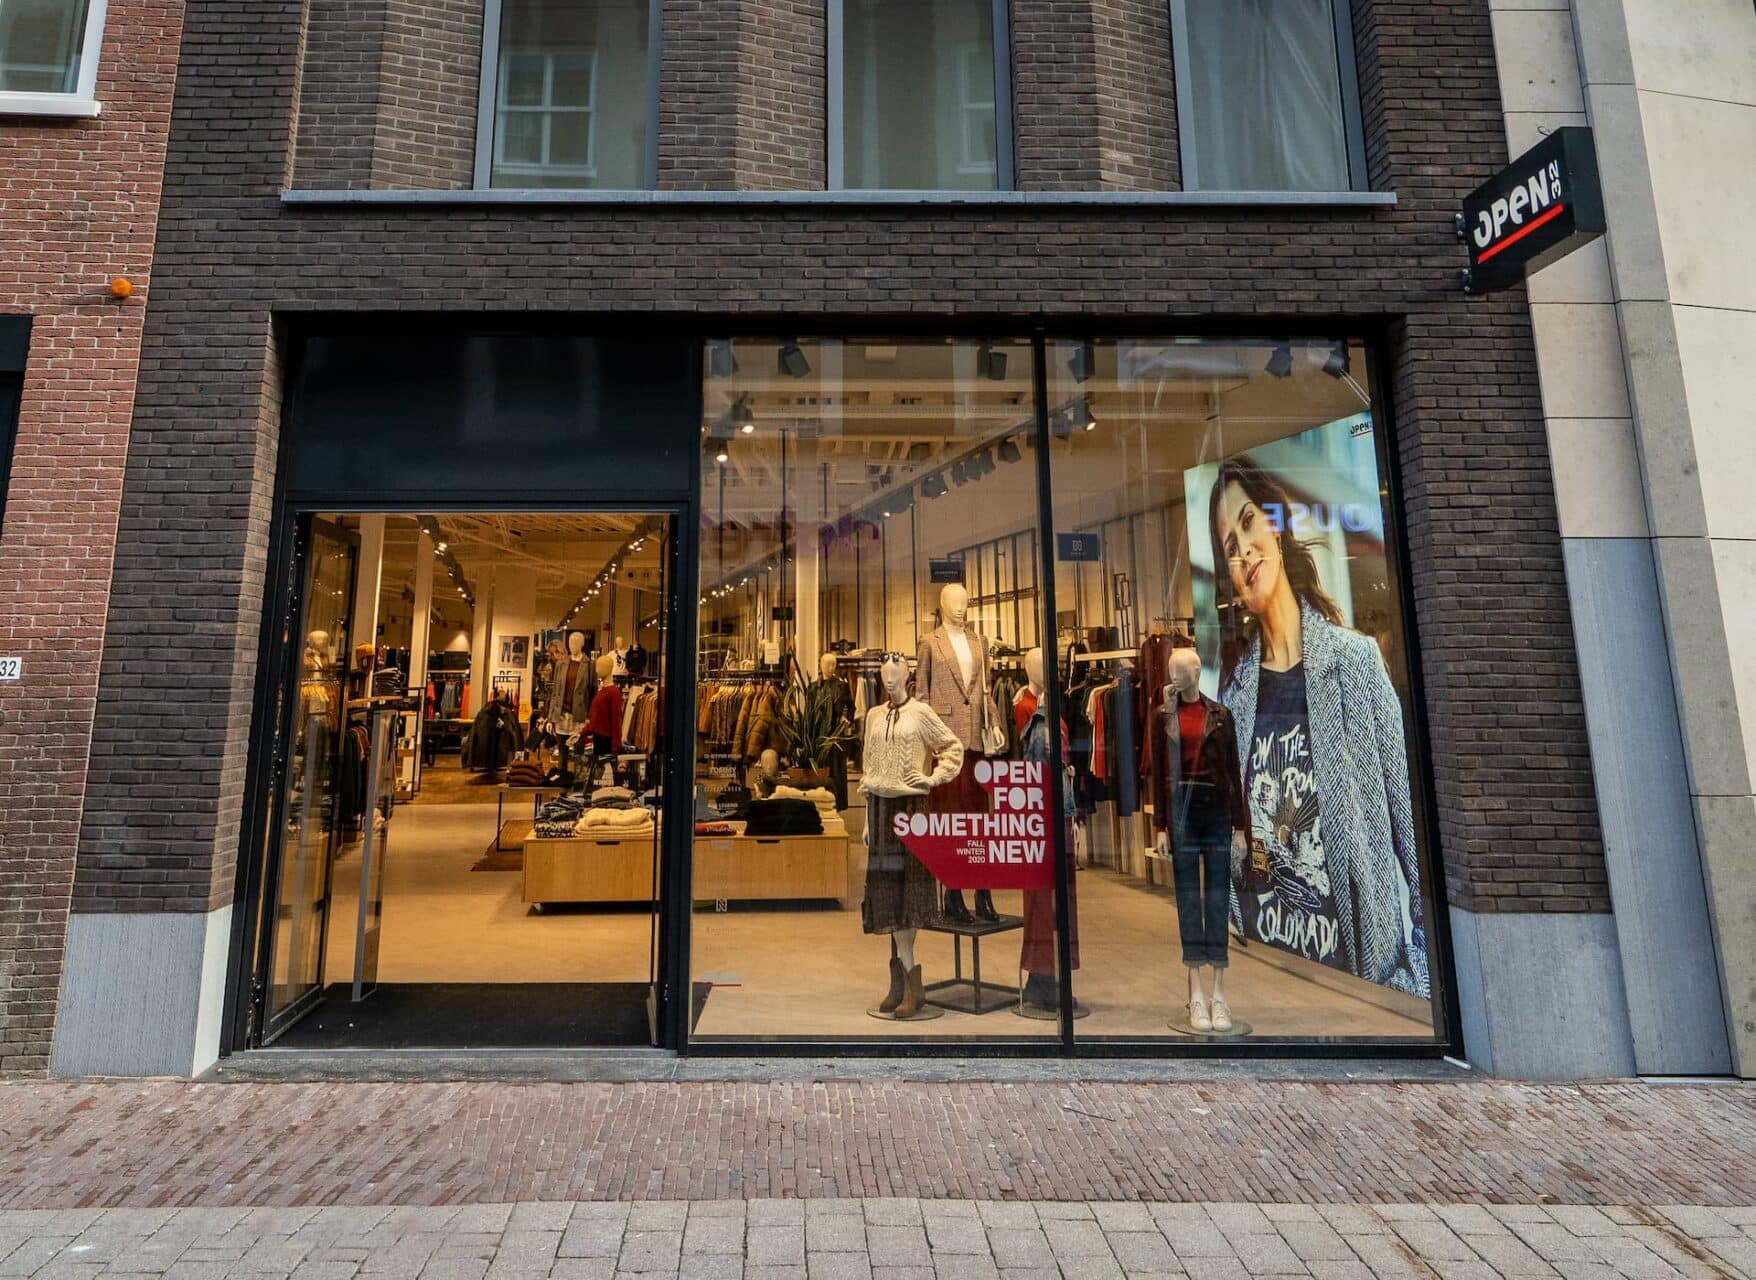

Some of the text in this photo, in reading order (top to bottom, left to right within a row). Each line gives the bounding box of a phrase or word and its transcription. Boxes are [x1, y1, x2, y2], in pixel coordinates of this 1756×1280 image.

[0, 660, 17, 677] 32
[974, 760, 1043, 784] OPEN
[994, 787, 1044, 810] FOR
[893, 812, 1045, 837] SOMETHING
[956, 847, 986, 856] WINTER
[967, 839, 985, 848] FALL
[988, 840, 1046, 864] NEW
[967, 855, 986, 864] 2020
